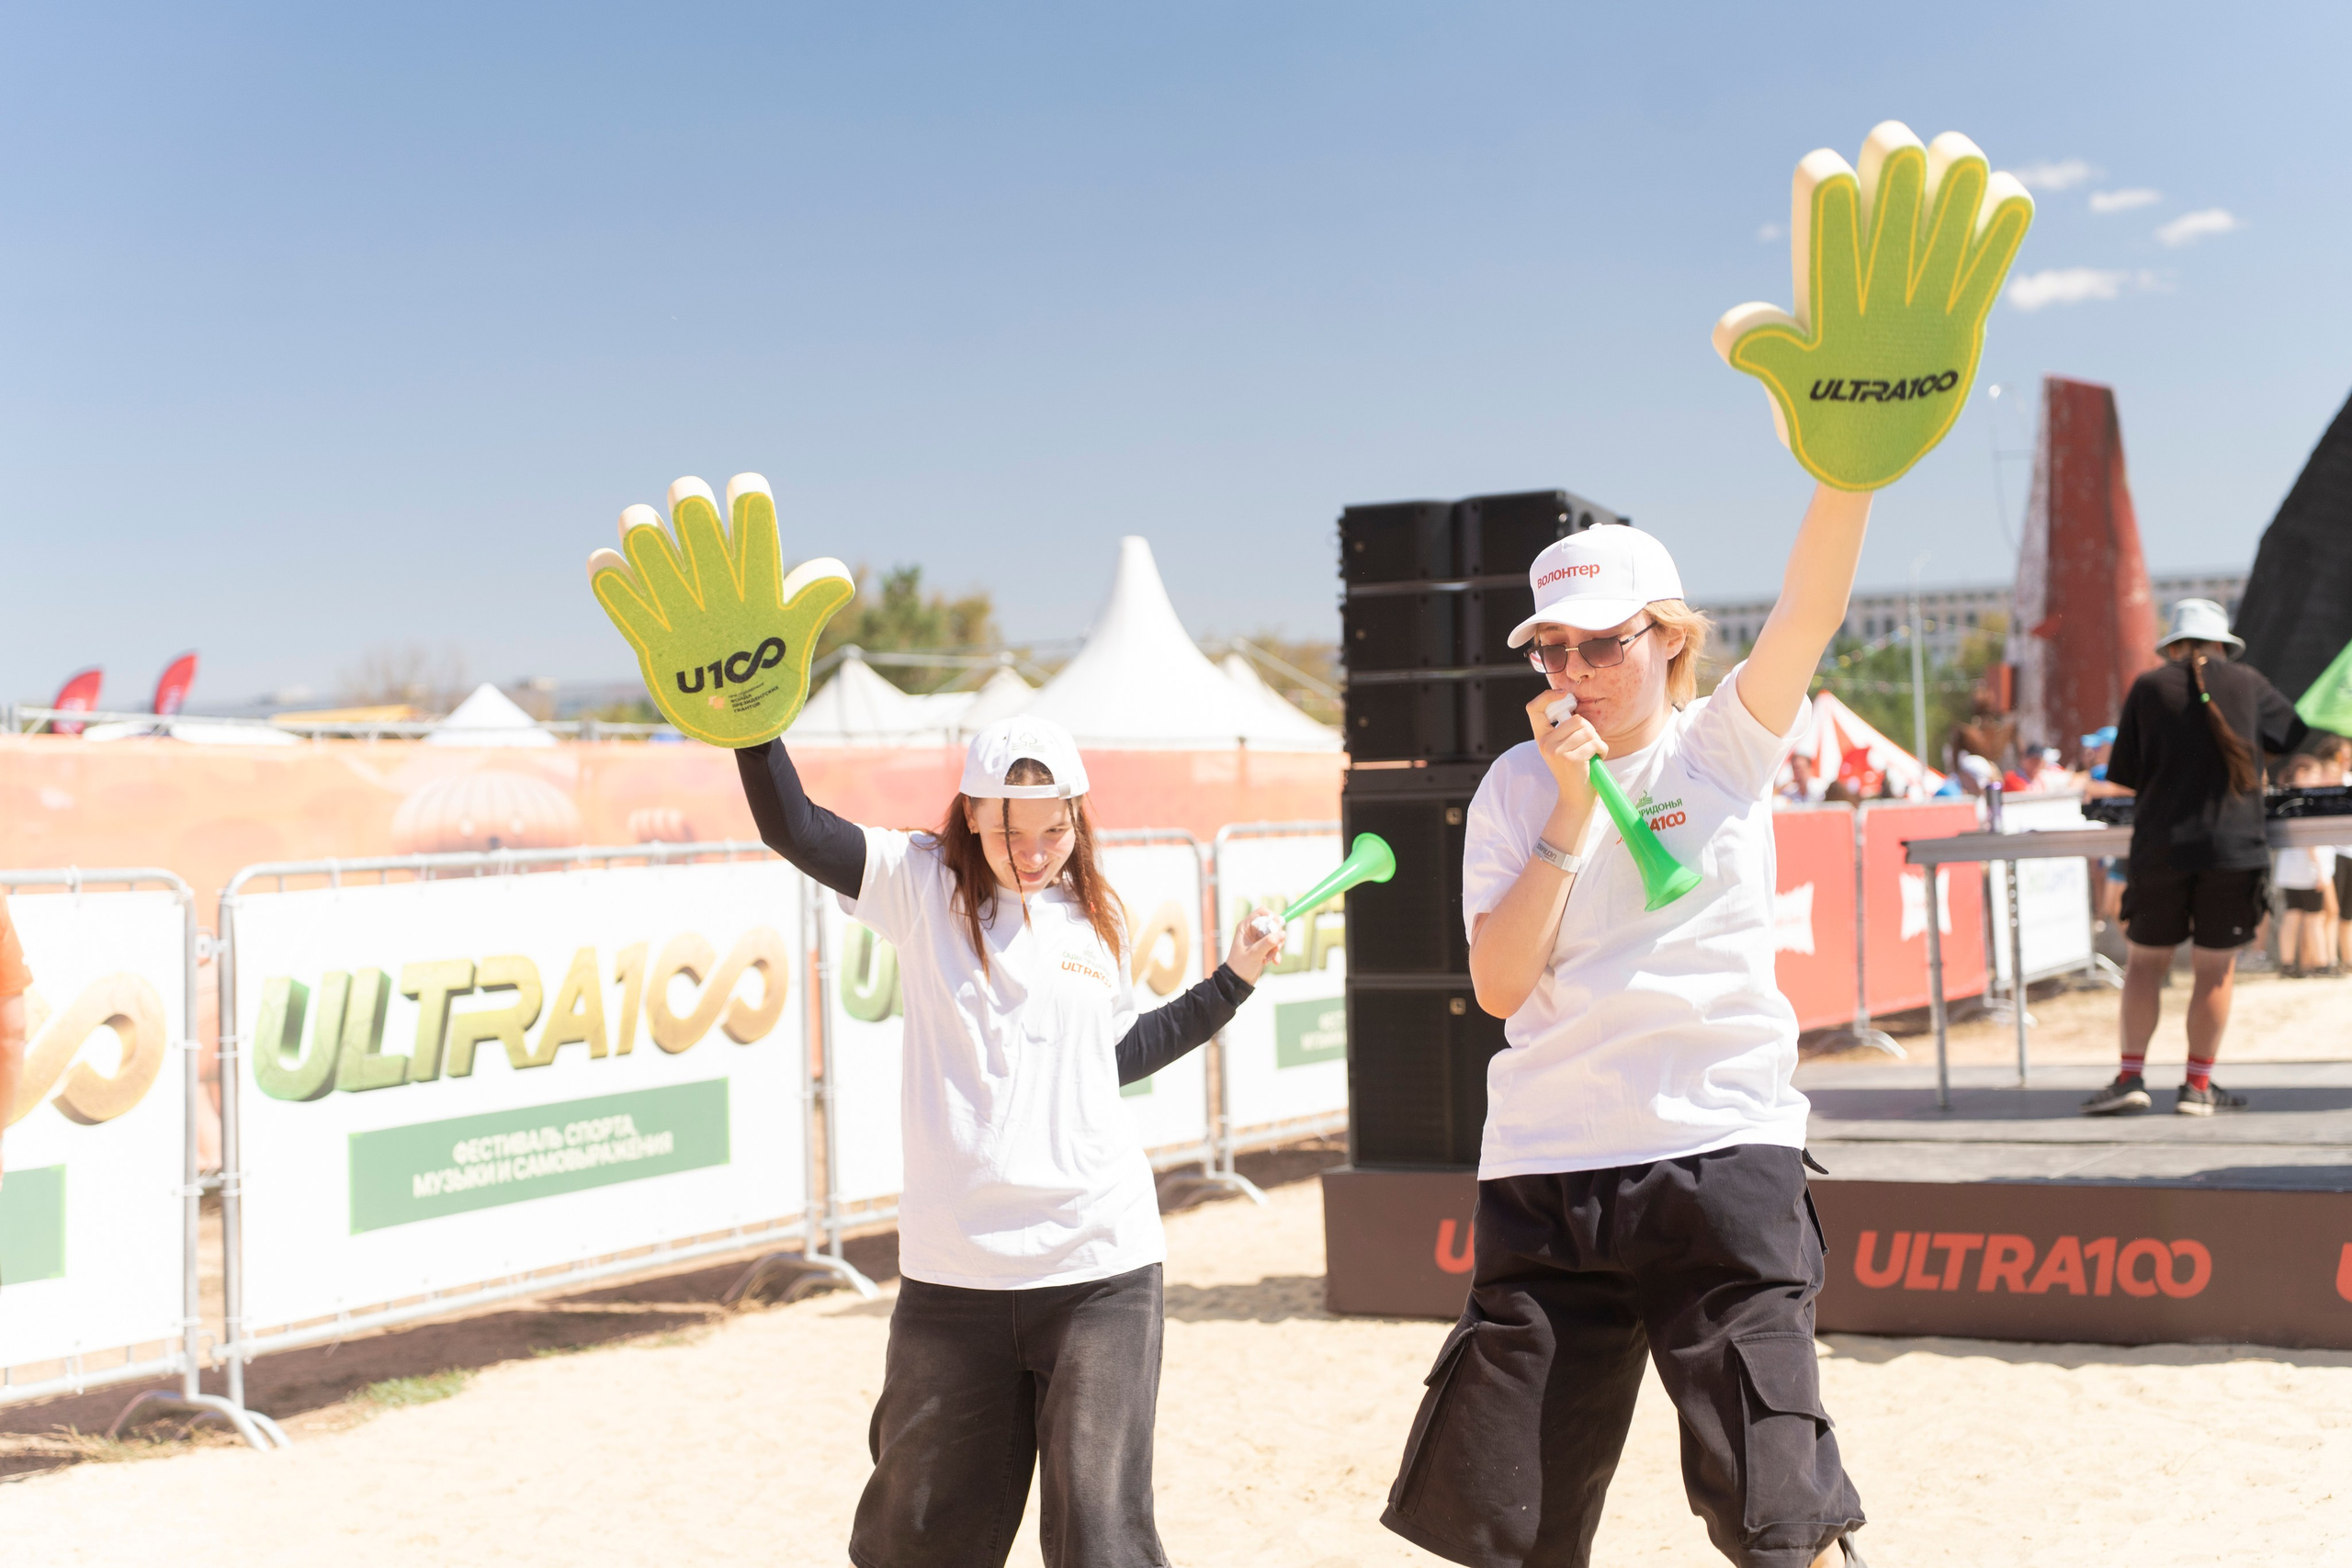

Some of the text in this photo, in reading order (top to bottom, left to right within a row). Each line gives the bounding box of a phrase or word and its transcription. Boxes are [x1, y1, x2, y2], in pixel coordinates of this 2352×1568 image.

[1809, 369, 1959, 403] ULTRA100
[1537, 563, 1600, 589] волонтер
[252, 925, 790, 1102] ULTRA100
[413, 1130, 673, 1199] МУЗЫКИ И САМОВЫРАЖЕНИЯ
[452, 1125, 563, 1166] ФЕСТИВАЛЬ
[1853, 1230, 2212, 1300] ULTRA100
